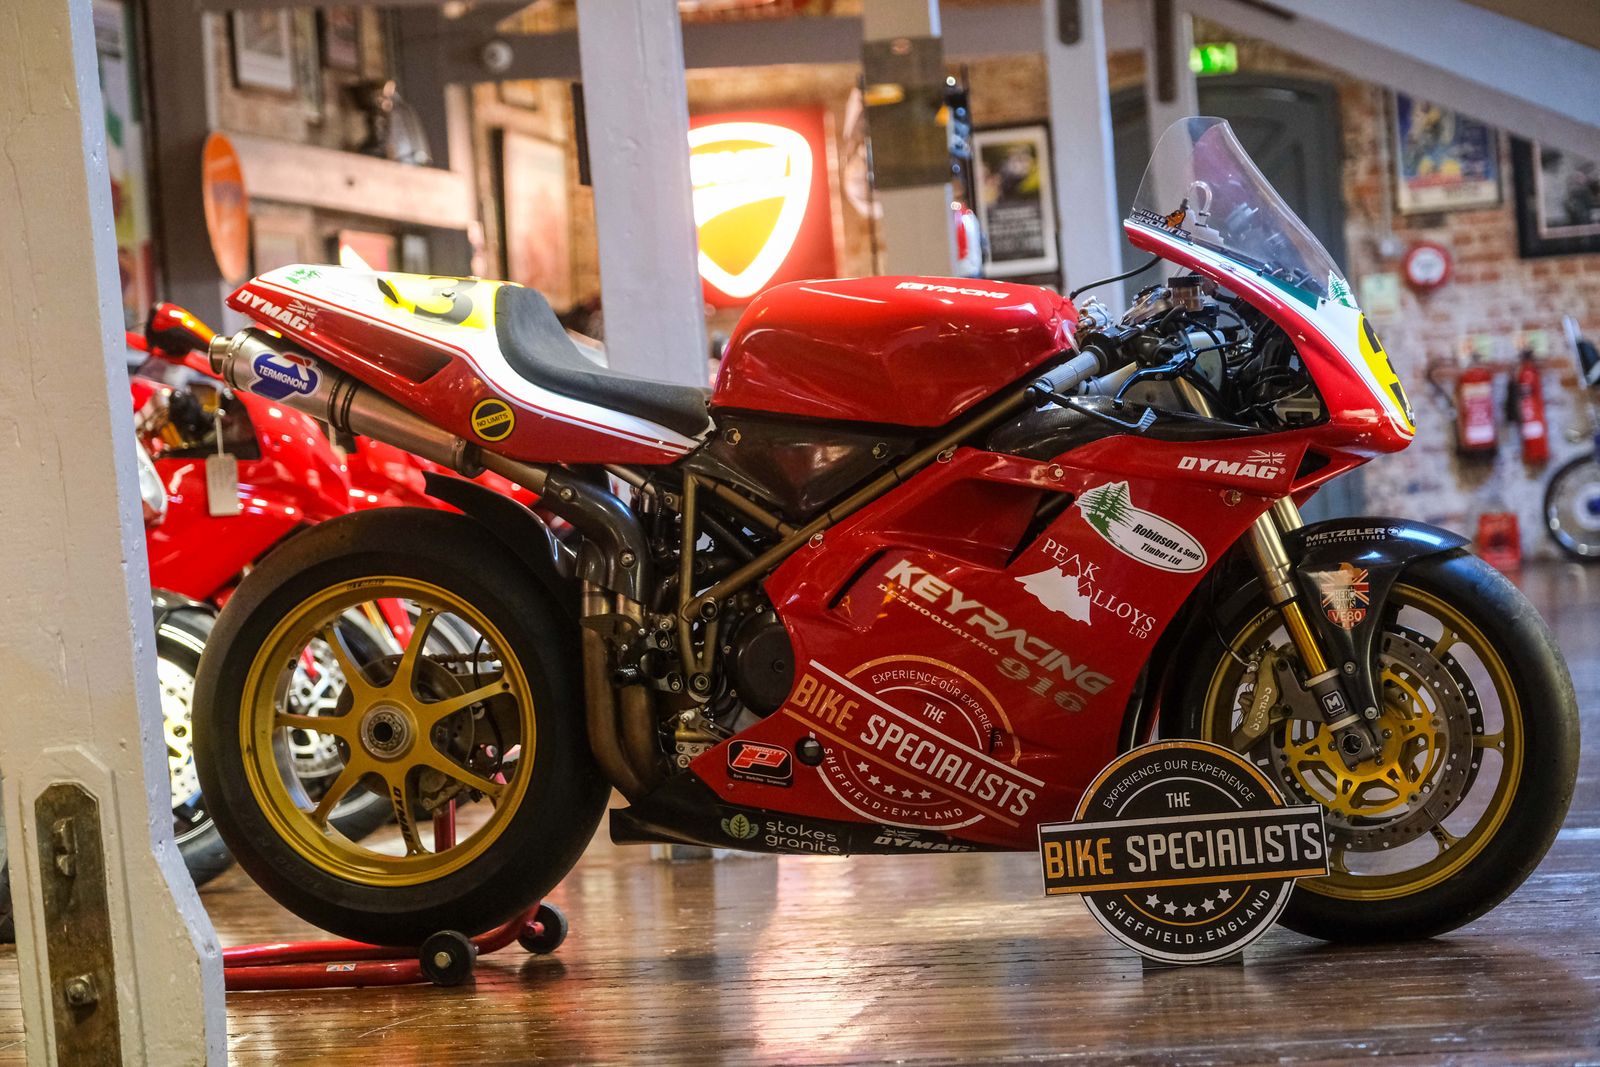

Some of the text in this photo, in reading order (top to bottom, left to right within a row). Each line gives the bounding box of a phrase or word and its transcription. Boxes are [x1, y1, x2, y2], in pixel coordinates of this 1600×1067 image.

[236, 289, 309, 331] DYMAG
[259, 364, 308, 391] TERMIGNONI
[476, 412, 509, 428] NO LIMITS
[1177, 456, 1279, 480] DYMAG
[1132, 523, 1180, 551] Robinson
[1182, 548, 1201, 561] Sons
[1305, 536, 1357, 547] MOTORCYCLE
[1306, 527, 1386, 542] METZELER
[1041, 538, 1101, 582] PEAK
[1140, 543, 1183, 566] Timber Ltd
[877, 583, 999, 656] DESMOQUATTRO
[884, 559, 1115, 696] KEYRACING
[1128, 625, 1148, 640] LTD
[872, 669, 937, 685] EXPERIENCE
[938, 679, 960, 697] OUR
[996, 656, 1089, 713] 916
[922, 702, 947, 724] THE
[789, 672, 1036, 817] BIKE SPECIALISTS
[1102, 759, 1256, 809] EXPERIENCE OUR EXPERIENCE
[1165, 791, 1191, 808] THE
[765, 834, 841, 854] granite
[766, 820, 838, 843] stokes
[873, 836, 973, 854] DYMAG
[1044, 822, 1323, 879] BIKE SPECIALISTS
